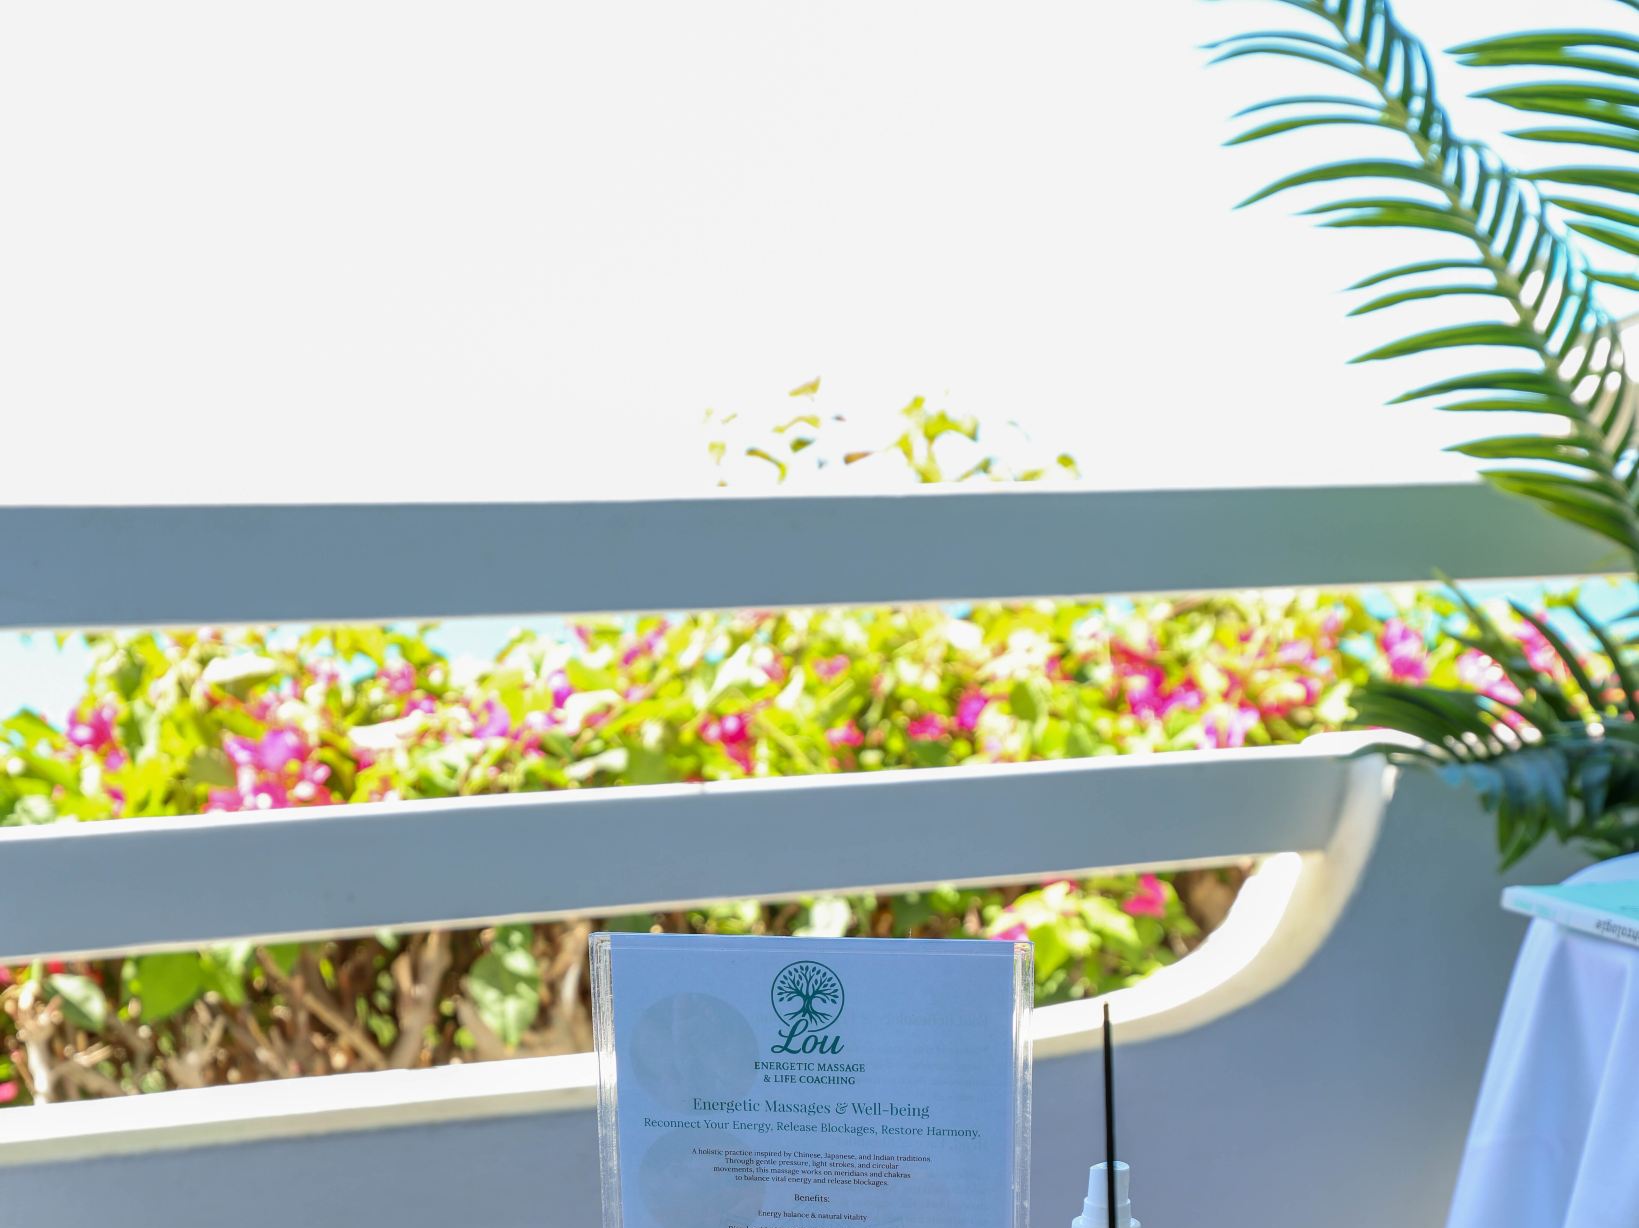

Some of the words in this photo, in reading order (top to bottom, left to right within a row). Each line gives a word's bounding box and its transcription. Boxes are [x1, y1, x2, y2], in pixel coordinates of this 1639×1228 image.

[771, 1018, 845, 1055] Lou
[754, 1061, 815, 1071] ENERGETIC
[817, 1063, 865, 1073] MASSAGE
[763, 1074, 771, 1083] &
[774, 1074, 797, 1084] LIFE
[799, 1075, 856, 1085] COACHING
[693, 1098, 760, 1114] Energetic
[764, 1099, 831, 1116] Massages
[835, 1102, 848, 1115] &
[851, 1102, 930, 1119] Well-being
[644, 1117, 701, 1129] Reconnect
[704, 1119, 730, 1130] Your
[776, 1121, 817, 1132] Release
[821, 1122, 878, 1136] Blockages,
[881, 1124, 923, 1136] Restore
[926, 1126, 981, 1140] Harmony.
[698, 1148, 722, 1156] holistic
[724, 1149, 752, 1159] practice
[754, 1150, 781, 1159] inspired
[783, 1150, 792, 1159] by
[793, 1151, 823, 1159] Chinese,
[858, 1153, 871, 1161] and
[725, 1157, 754, 1166] Through
[755, 1158, 777, 1167] gentle
[778, 1159, 811, 1167] pressure,
[812, 1160, 827, 1168] light
[872, 1162, 899, 1170] circular
[713, 1166, 755, 1174] movements,
[756, 1166, 768, 1174] this
[770, 1168, 800, 1176] massage
[834, 1169, 867, 1177] meridians
[869, 1170, 882, 1178] and
[884, 1171, 911, 1179] chakras
[743, 1174, 770, 1182] balance
[787, 1176, 812, 1184] energy
[827, 1177, 852, 1185] release
[794, 1193, 830, 1203] Benefits:
[758, 1210, 781, 1219] Energy
[783, 1211, 810, 1219] balance
[843, 1213, 868, 1222] vitality
